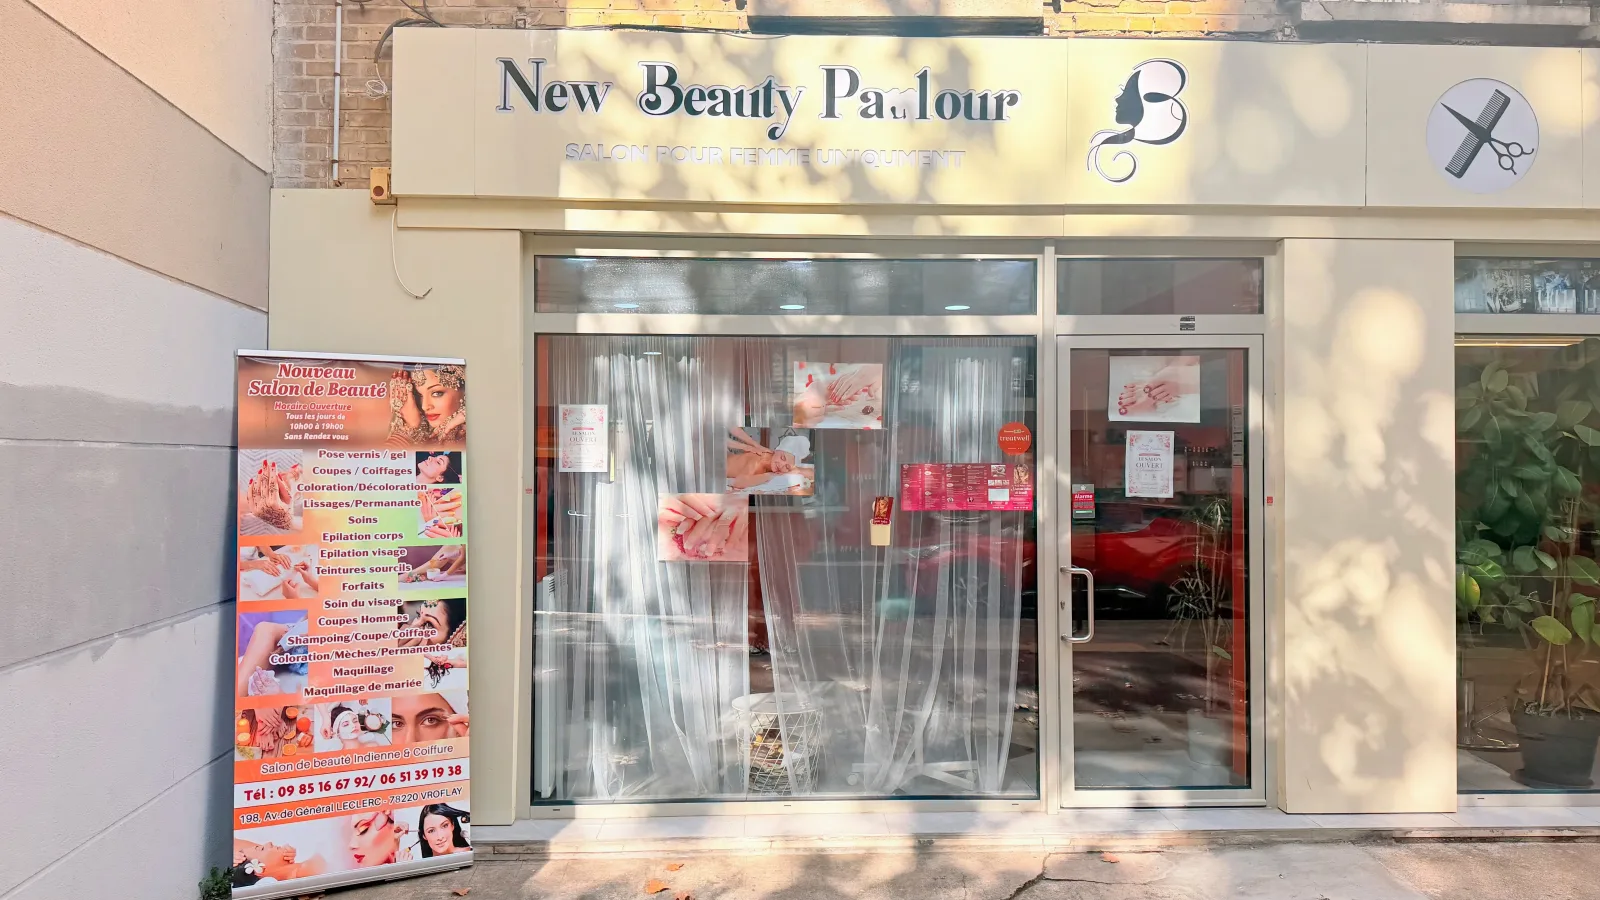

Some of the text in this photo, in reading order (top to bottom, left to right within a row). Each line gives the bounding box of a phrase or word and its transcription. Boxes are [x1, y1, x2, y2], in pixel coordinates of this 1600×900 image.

[495, 57, 612, 115] New
[637, 61, 806, 140] Beauty
[565, 143, 967, 168] SALON POUR FEMME UNIQUMENT
[277, 364, 356, 379] Nouveau
[249, 381, 387, 397] Salon de Beauté
[274, 402, 352, 411] Horaire Ouverture
[316, 413, 335, 421] jours
[318, 451, 346, 459] Pose
[347, 451, 380, 459] vernis
[390, 451, 407, 461] gel
[312, 467, 352, 477] Coupes
[362, 467, 412, 477] Coiffages
[297, 482, 428, 493] Coloration/Décoloration
[303, 499, 421, 509] Lissages/Permanante
[348, 516, 378, 525] Soins
[322, 532, 404, 543] Epilation corps
[320, 548, 407, 559] Epilation visage
[315, 563, 411, 575] Teintures sourcils
[342, 581, 385, 591] Forfaits
[324, 597, 402, 609] Soin du visage
[318, 613, 409, 627] Coupes Hommes
[287, 628, 437, 645] Shampoing/Coupe/Coiffage
[333, 664, 394, 677] Maquillage
[304, 678, 422, 697] Maquillage de mariée
[261, 744, 454, 774] Salon de beauté Indienne & Coiffure
[244, 788, 266, 801] Tél
[277, 785, 295, 797] 09
[298, 783, 315, 795] 85
[318, 781, 332, 792] 16
[335, 778, 351, 790] 67
[380, 772, 396, 785] 06
[399, 770, 411, 782] 51
[414, 768, 429, 780] 39
[432, 766, 445, 778] 19
[447, 764, 463, 776] 38
[240, 813, 262, 824] 198,
[295, 804, 334, 817] Général
[336, 797, 382, 811] LECLERC
[389, 793, 419, 805] 78220
[421, 787, 464, 800] VROFLAY
